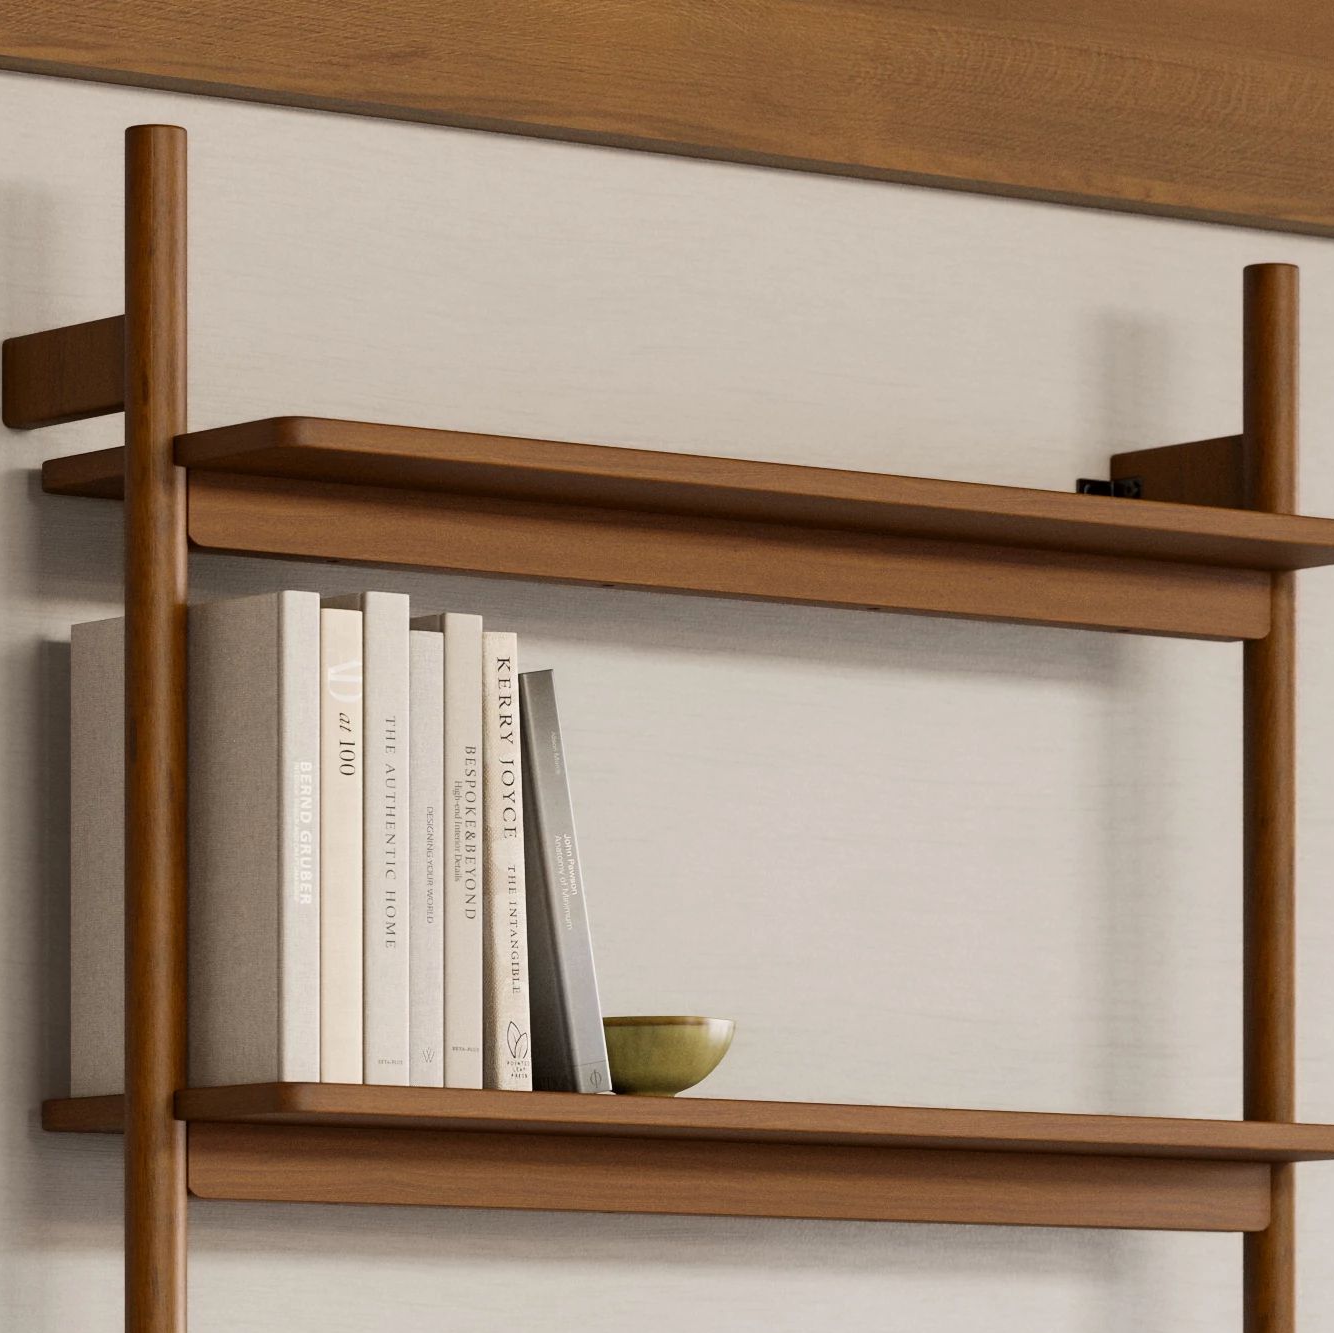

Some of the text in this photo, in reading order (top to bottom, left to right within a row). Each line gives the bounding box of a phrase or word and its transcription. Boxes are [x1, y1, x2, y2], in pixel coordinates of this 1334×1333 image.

[339, 712, 356, 777] at 100
[496, 656, 518, 840] KERRY JOYCE
[299, 760, 313, 905] BERND GRUBER
[385, 715, 397, 950] THE AUTHENTIC HOME
[425, 805, 435, 924] DESIGNING YOUR WORLD
[453, 780, 463, 883] High-end Interior Details
[464, 745, 477, 921] BESPOKE&BEYOND
[553, 833, 574, 931] Anatomy of Minimum
[562, 832, 579, 896] John Pawson
[507, 864, 522, 995] THE INTANGIBLE
